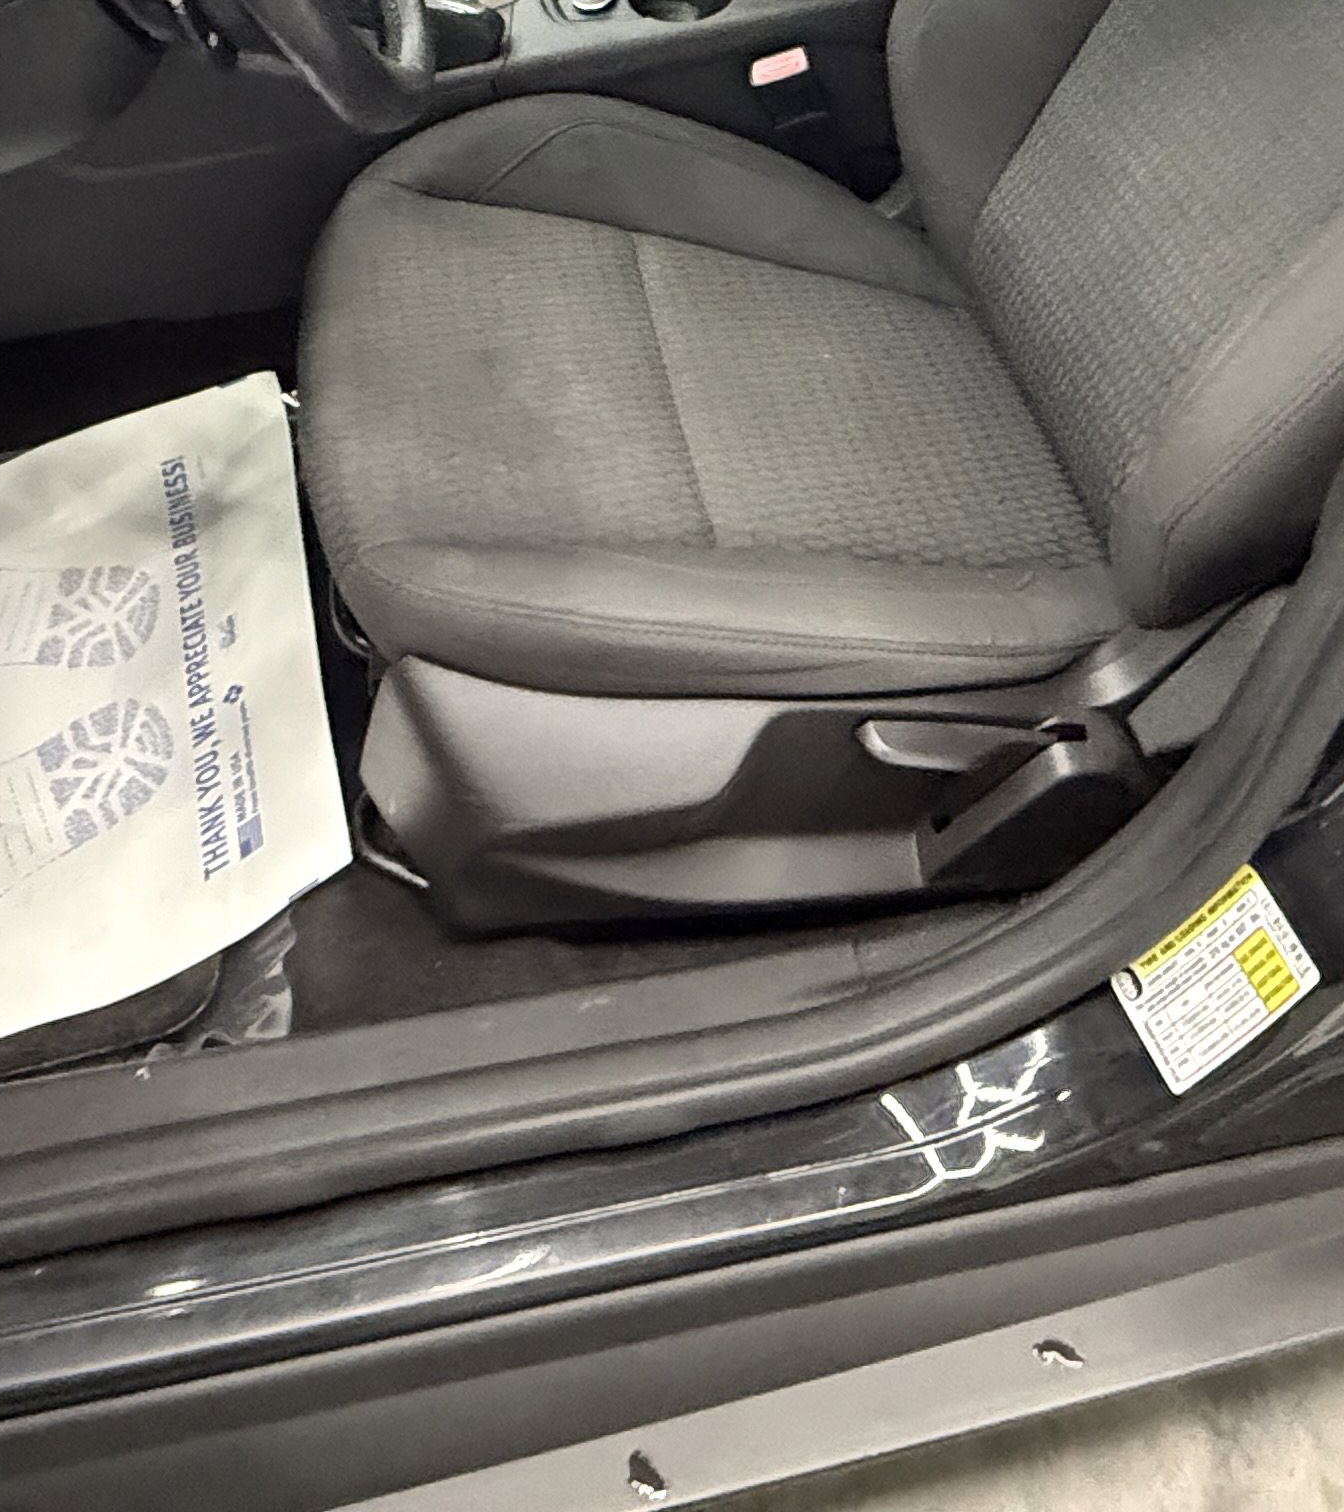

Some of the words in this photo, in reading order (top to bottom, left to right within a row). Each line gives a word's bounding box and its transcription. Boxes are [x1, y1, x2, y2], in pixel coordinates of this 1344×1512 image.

[160, 456, 197, 549] BUSINESS!
[174, 548, 202, 602] YOUR
[179, 598, 213, 708] APPRECIATE
[190, 707, 216, 748] WE
[194, 739, 222, 802] YOU,
[230, 750, 242, 775] USA
[234, 789, 247, 823] MADE
[198, 795, 230, 882] THANK
